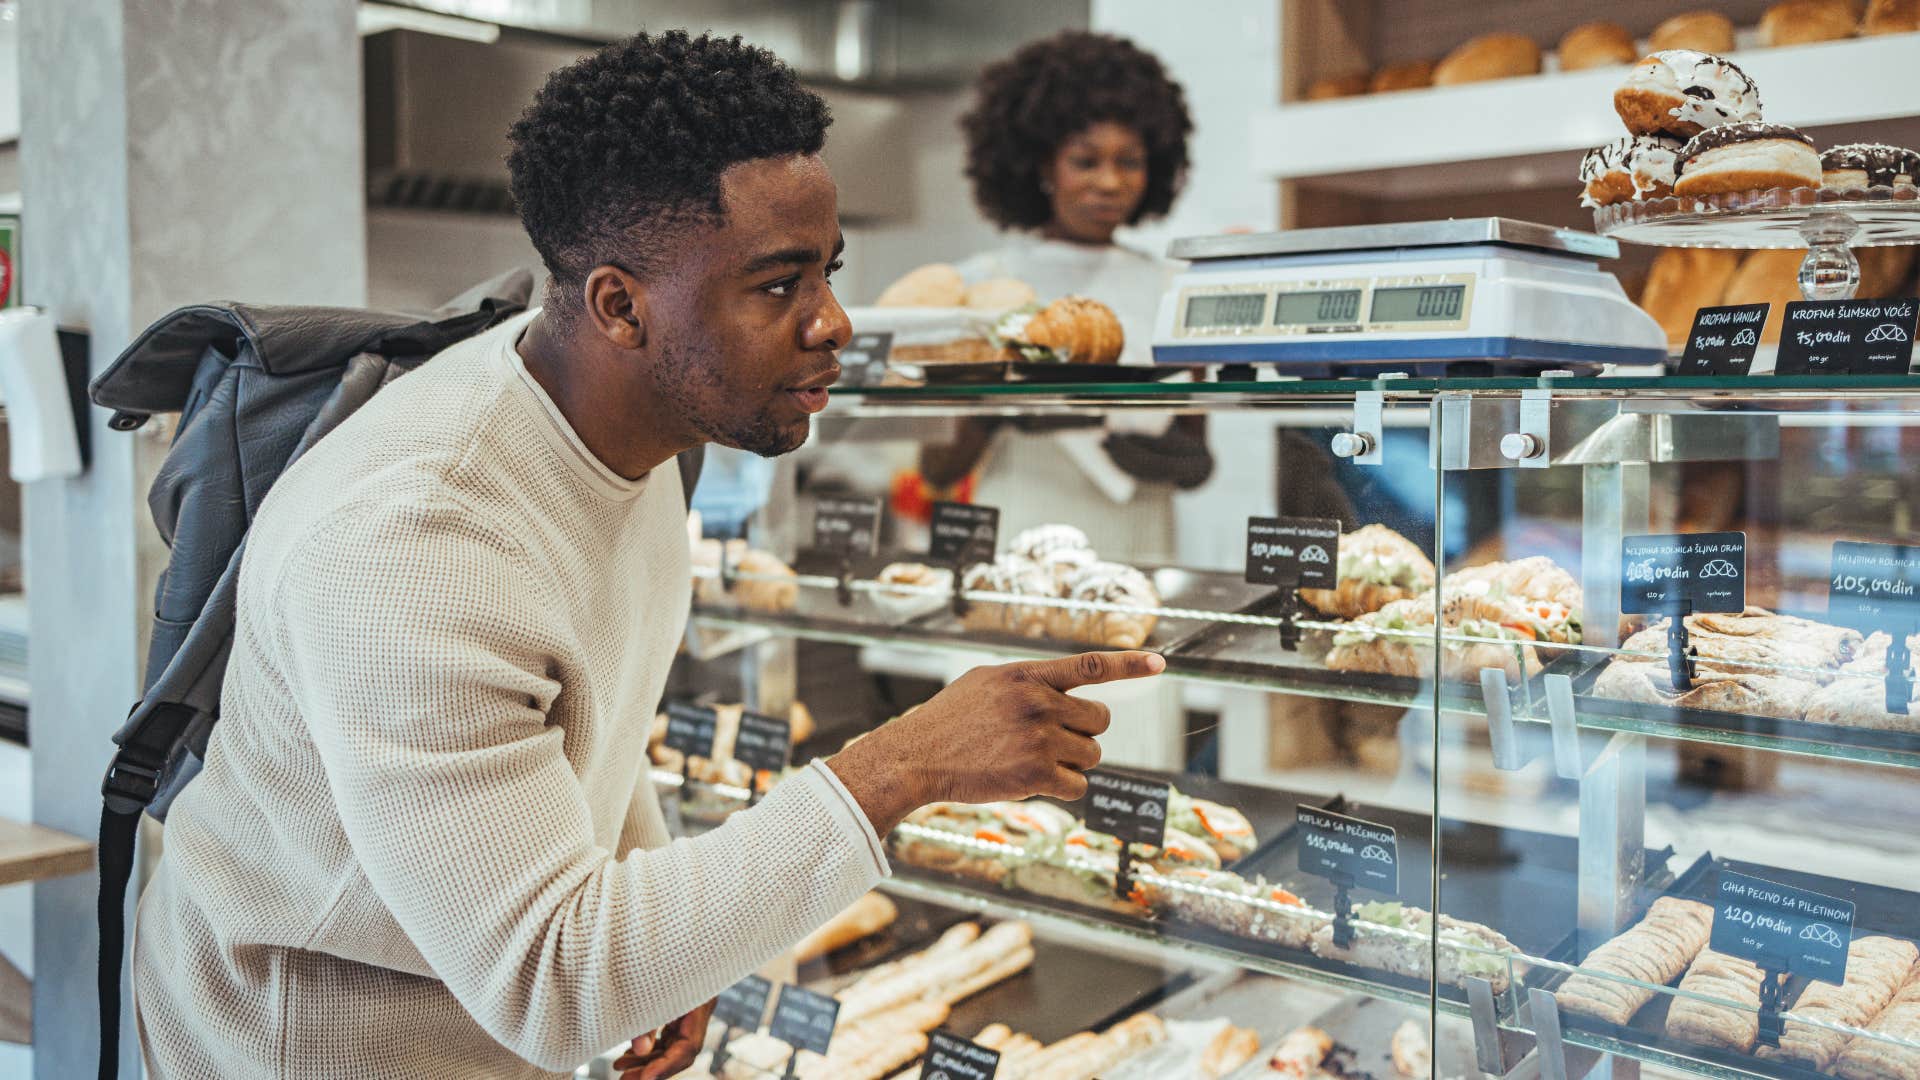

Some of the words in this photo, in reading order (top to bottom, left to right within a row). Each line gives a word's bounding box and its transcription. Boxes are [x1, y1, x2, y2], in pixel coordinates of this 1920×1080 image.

[1699, 311, 1731, 326] KROFNA
[1732, 309, 1762, 324] VANILA
[1792, 308, 1836, 320] KROFNA
[1838, 305, 1881, 319] ŠUMSKO
[1883, 302, 1912, 318] VOĆE
[1694, 543, 1718, 555] ŠLJIVA
[1832, 573, 1914, 596] 105,00din
[1722, 881, 1746, 895] CHIA
[1747, 887, 1781, 904] PECIVO
[1781, 896, 1796, 908] SA
[1798, 900, 1851, 922] PILETINOM
[1723, 904, 1792, 936] 120,00din
